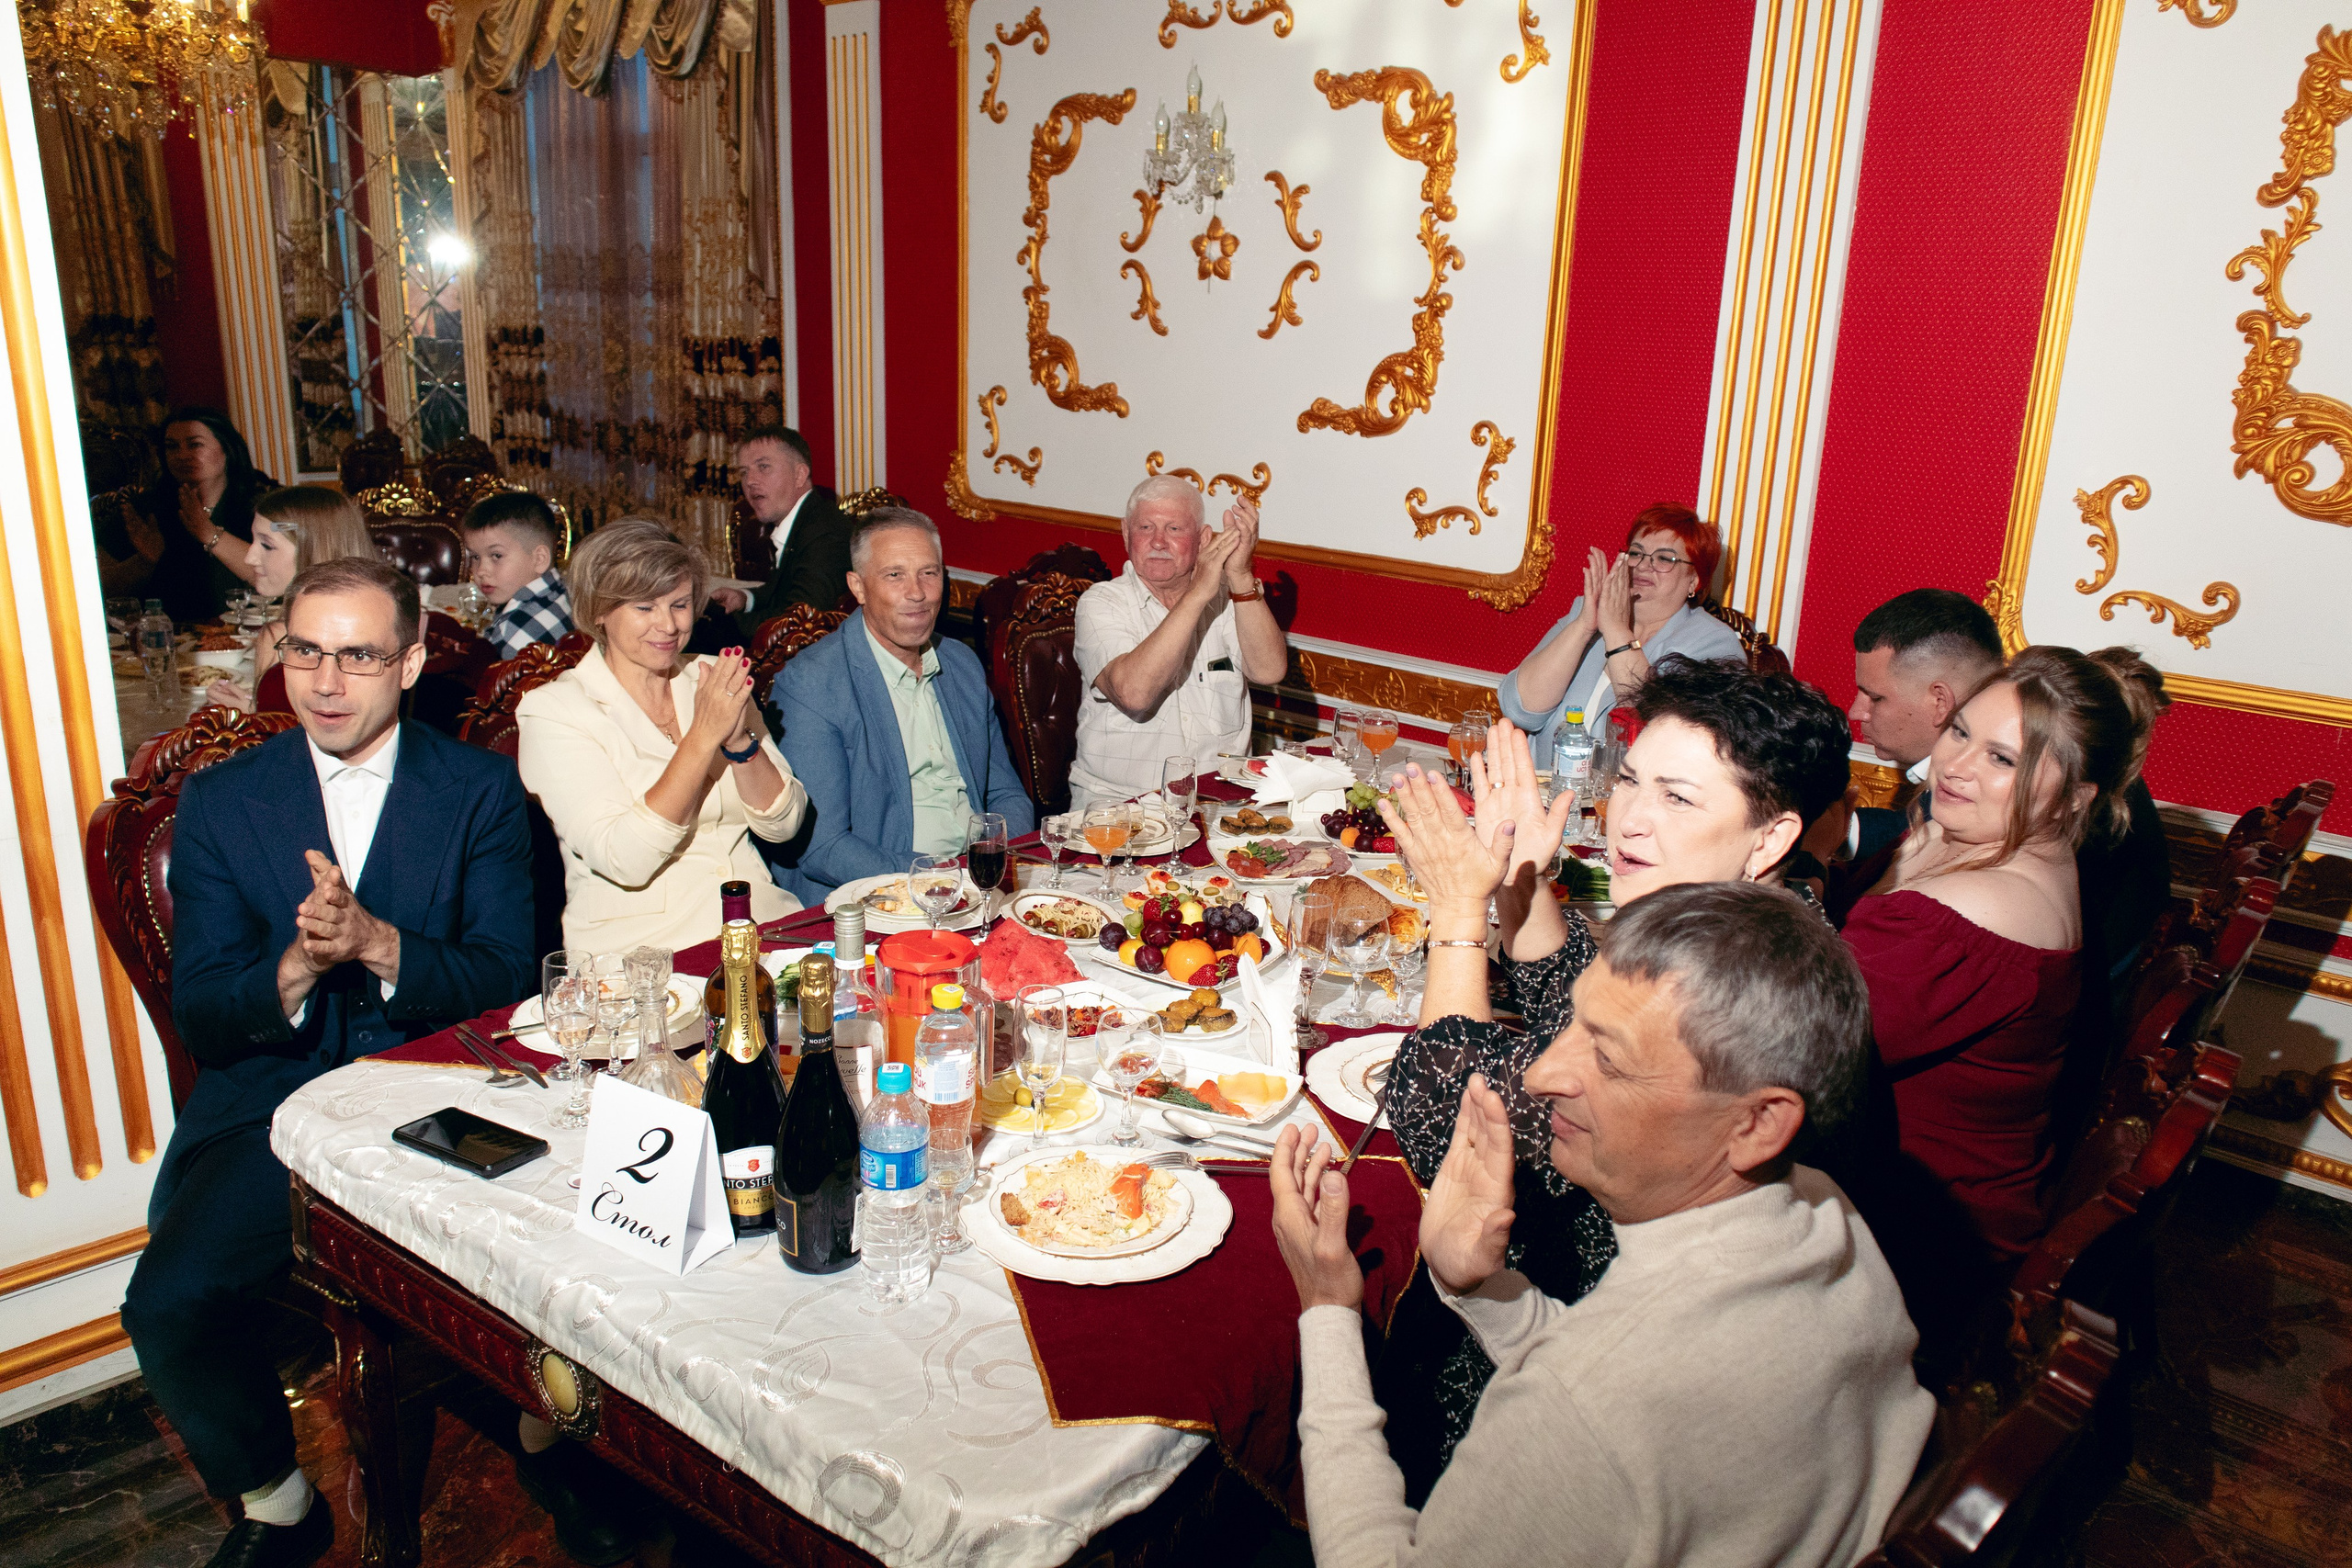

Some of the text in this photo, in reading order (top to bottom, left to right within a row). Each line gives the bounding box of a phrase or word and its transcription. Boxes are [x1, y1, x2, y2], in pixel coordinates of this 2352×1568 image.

[740, 975, 750, 1041] SANTO STEFANO
[808, 1035, 831, 1044] NOZECO
[616, 1127, 674, 1184] 2
[724, 1179, 746, 1190] NTO
[592, 1181, 672, 1247] Стол
